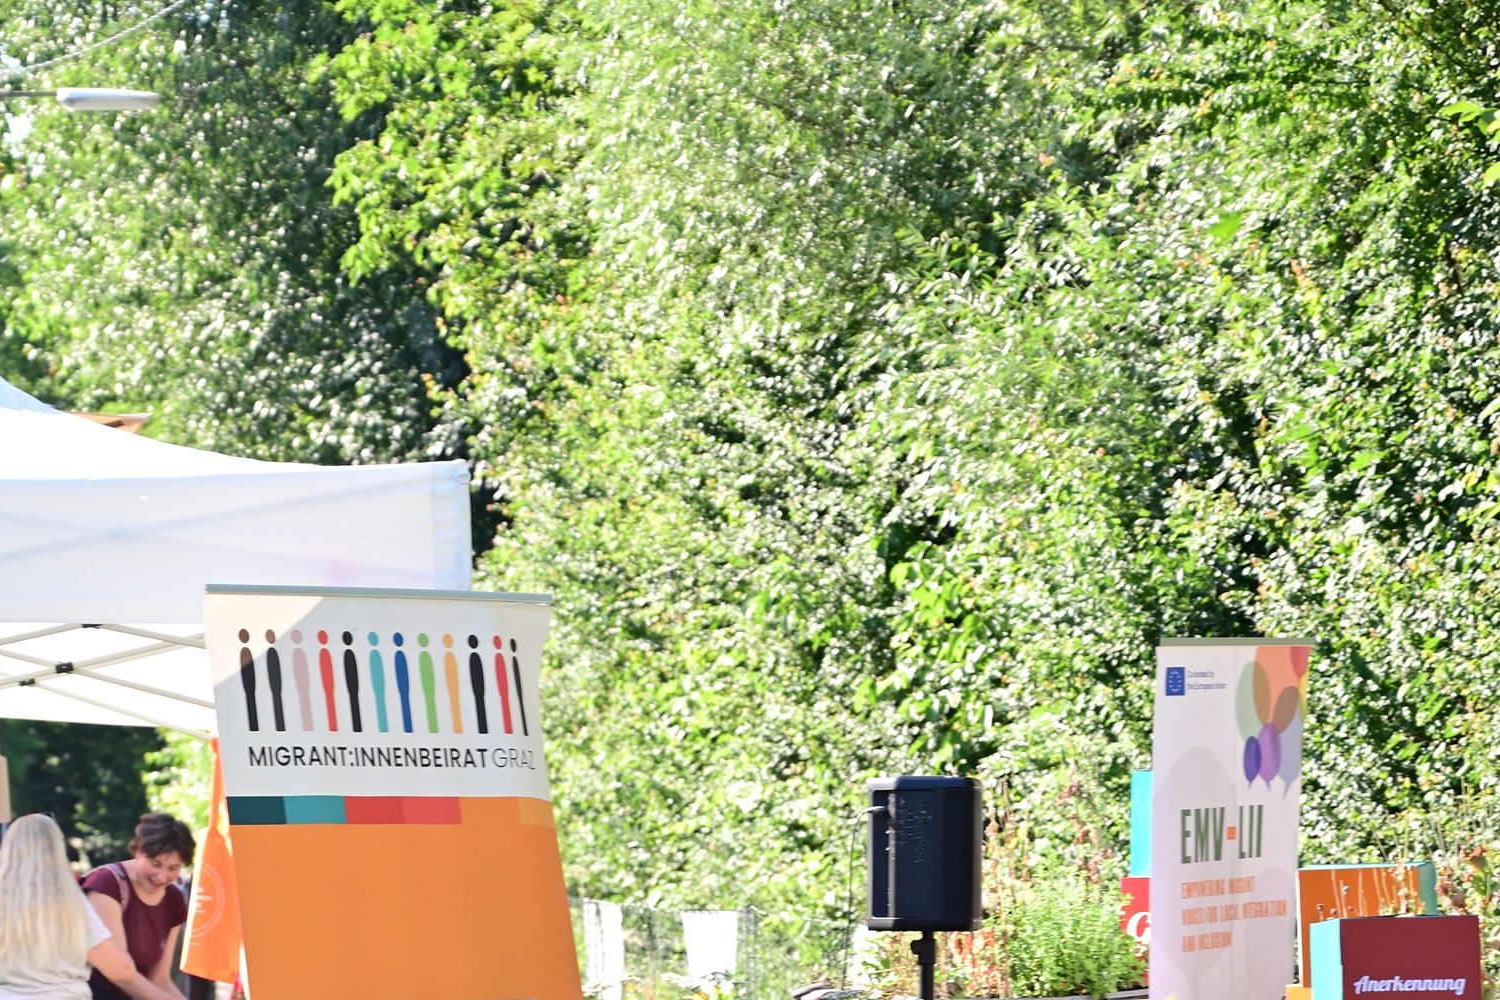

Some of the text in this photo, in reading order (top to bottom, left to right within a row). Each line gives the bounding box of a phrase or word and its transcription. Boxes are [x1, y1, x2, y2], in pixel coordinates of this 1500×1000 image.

[248, 745, 536, 770] MIGRANT:INNENBEIRAT GRAZ
[1353, 975, 1467, 996] Anerkennung
